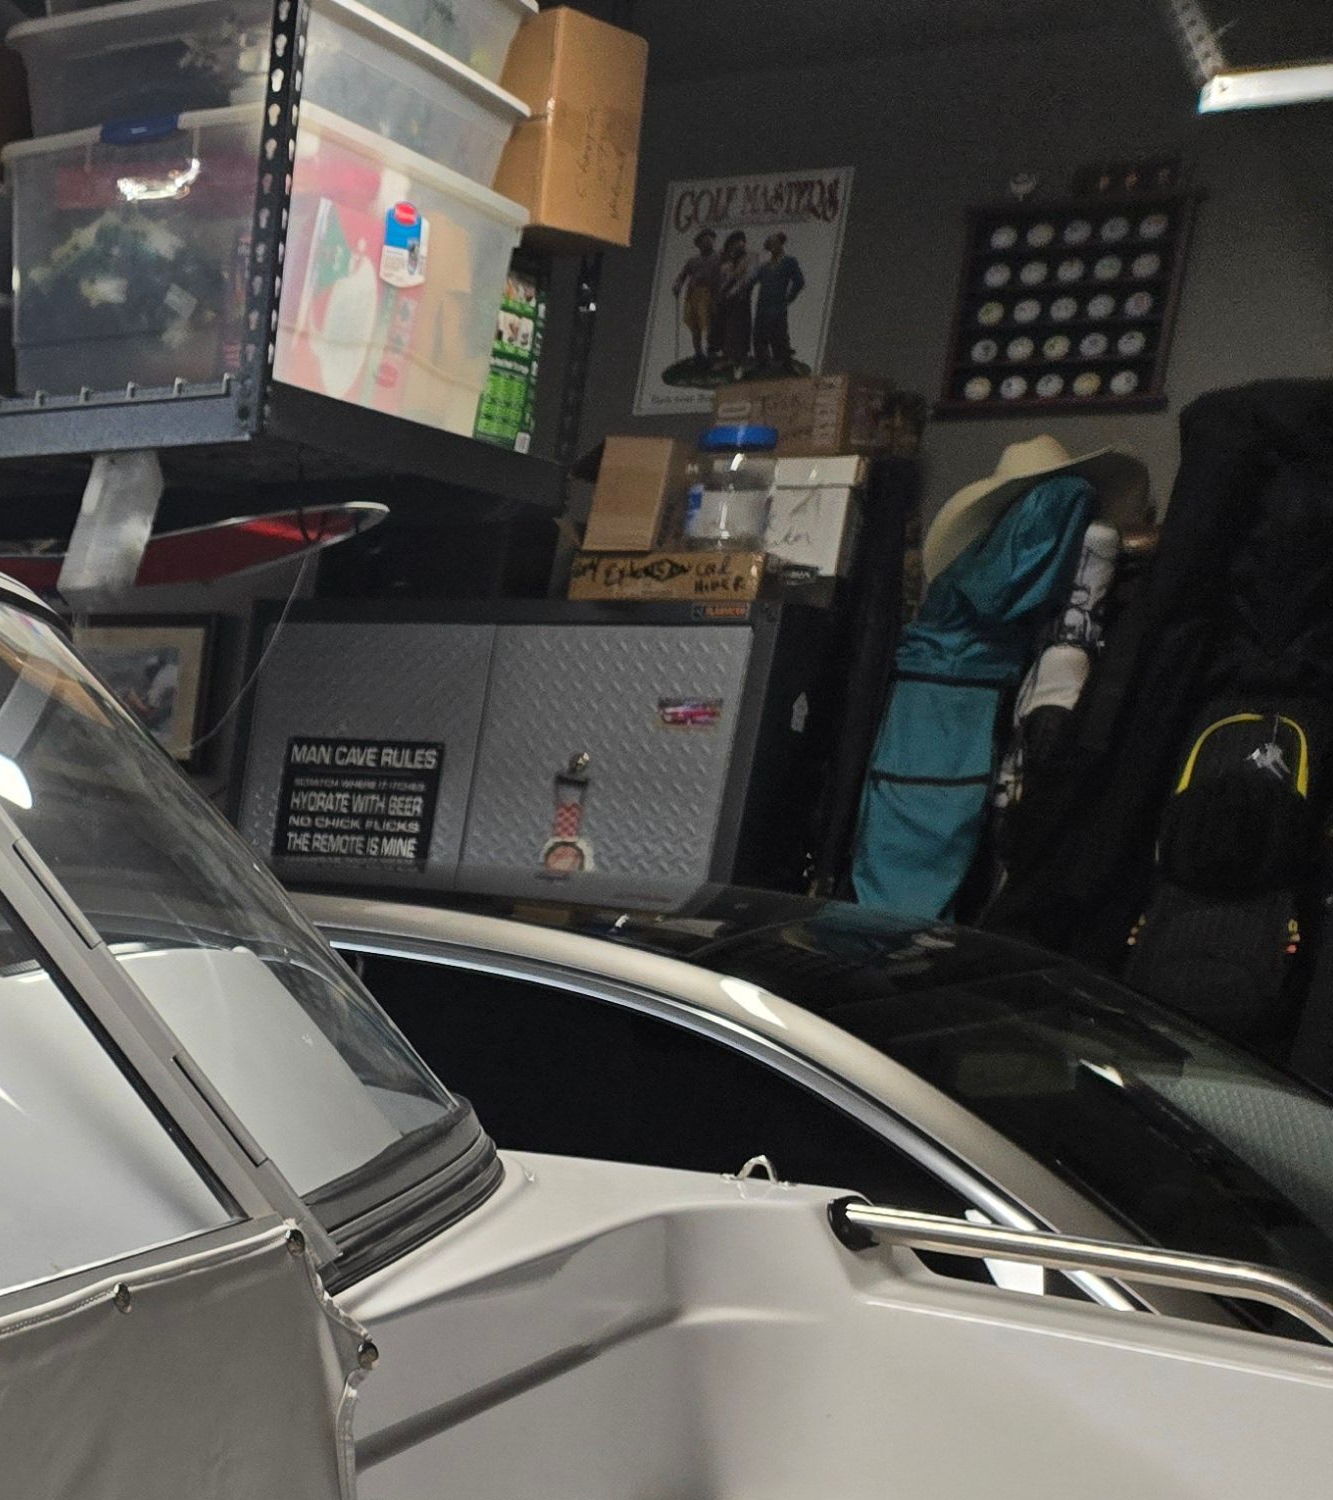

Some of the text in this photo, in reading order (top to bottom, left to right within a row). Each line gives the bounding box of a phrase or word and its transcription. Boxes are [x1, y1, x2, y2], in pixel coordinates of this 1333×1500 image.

[291, 744, 437, 770] MAN CAVE RULES
[290, 791, 424, 817] HYDRATE WITH BEER
[288, 815, 420, 834] NO CHICK FLICKS
[287, 833, 418, 858] THE REMOTE IS MINE
